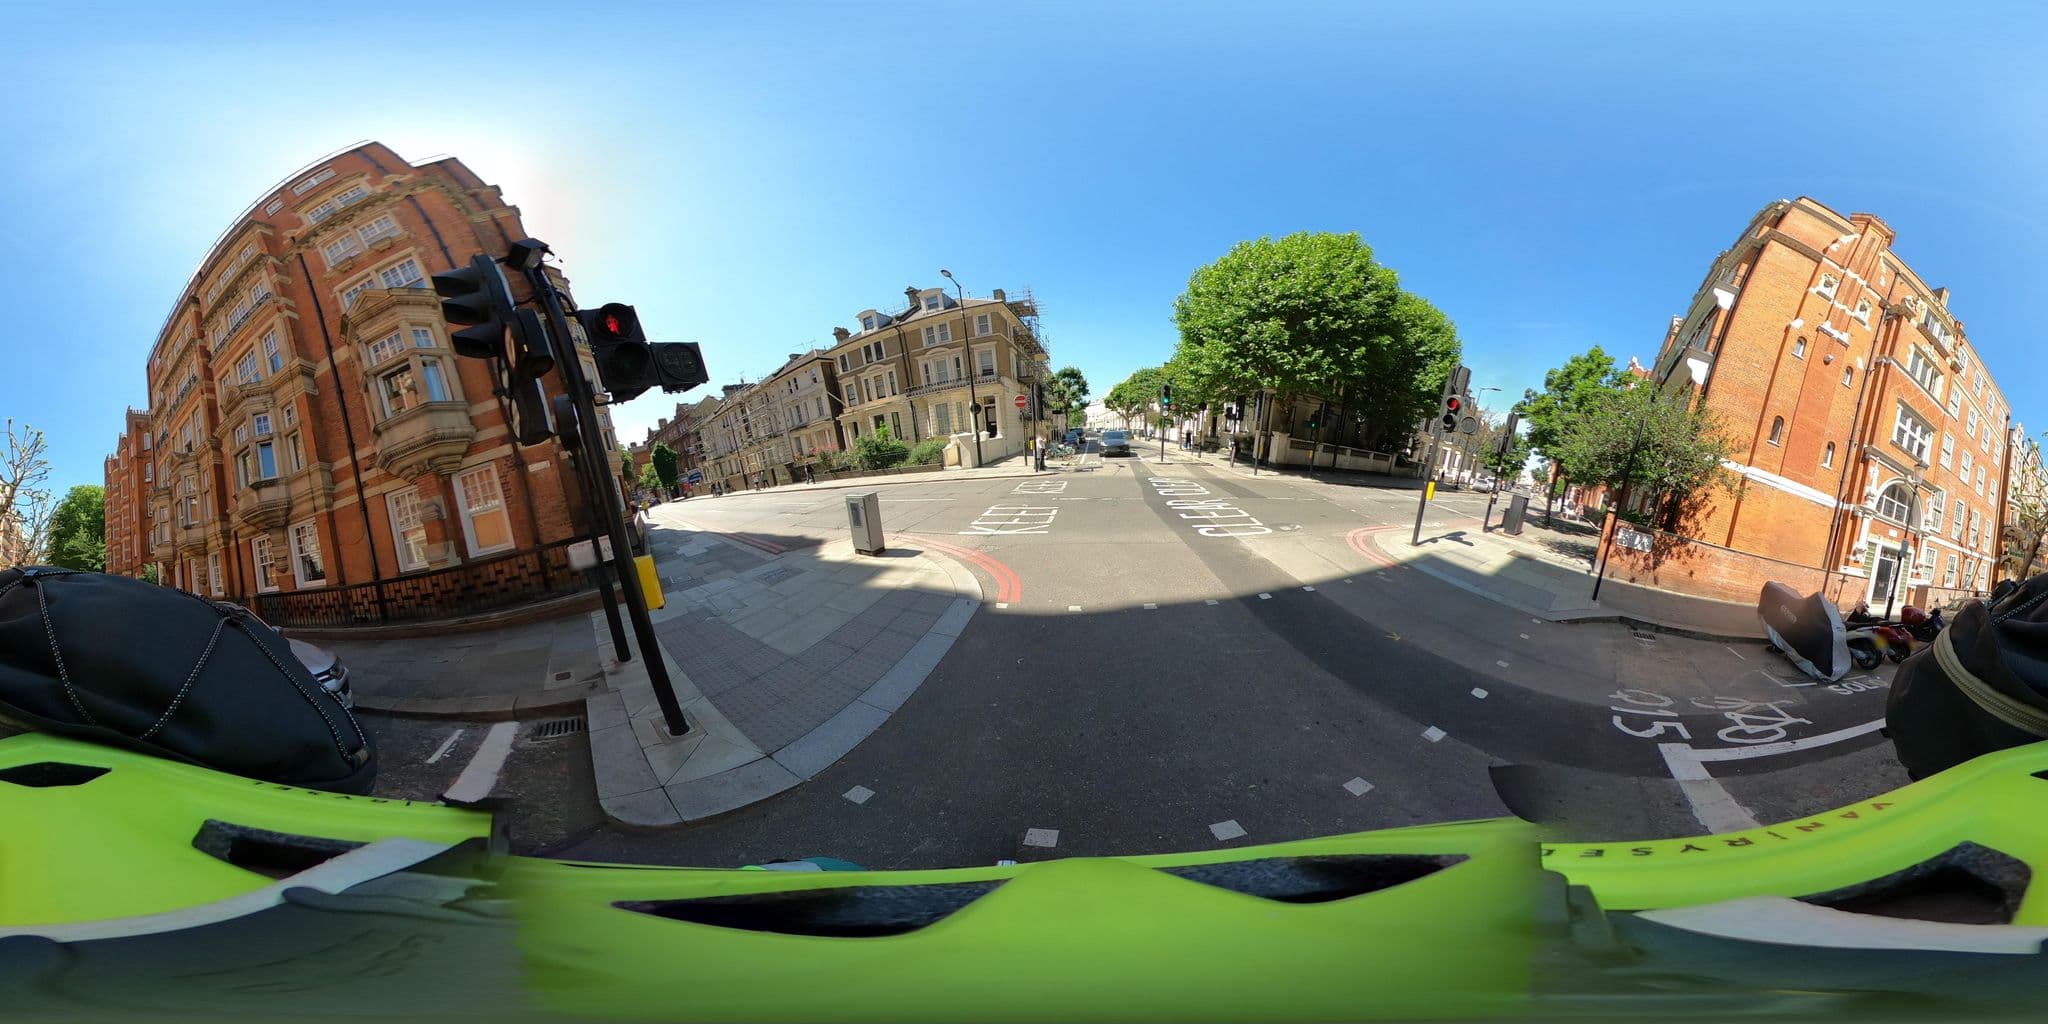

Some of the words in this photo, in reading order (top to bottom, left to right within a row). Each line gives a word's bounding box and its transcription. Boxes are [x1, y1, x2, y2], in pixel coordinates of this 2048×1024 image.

[1010, 480, 1068, 494] KEEP
[958, 503, 1059, 535] KEEP
[1166, 499, 1273, 537] CLEAR
